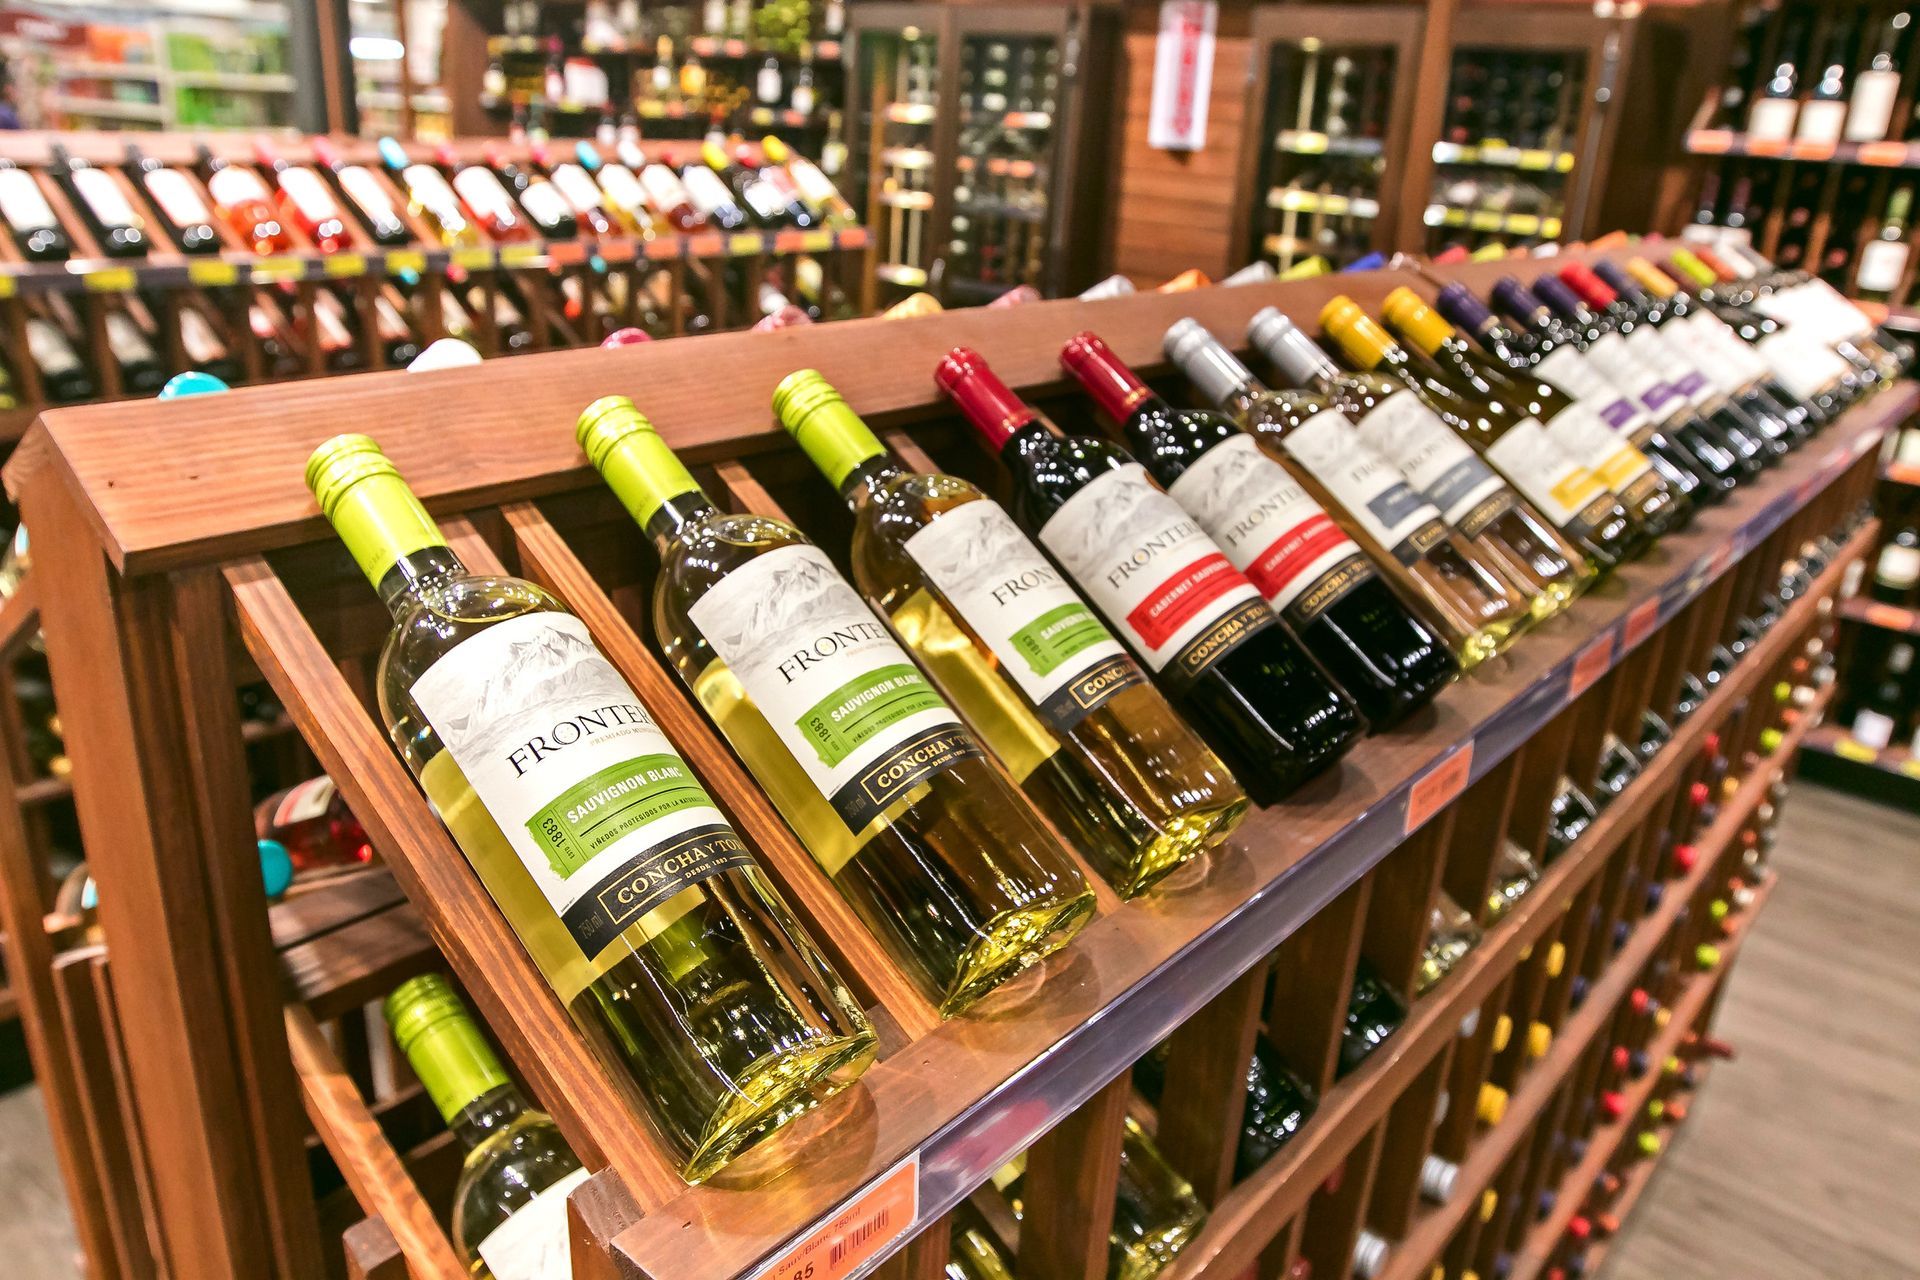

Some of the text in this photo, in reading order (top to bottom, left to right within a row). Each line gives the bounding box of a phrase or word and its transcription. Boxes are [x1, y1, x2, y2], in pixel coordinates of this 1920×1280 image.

[1188, 619, 1244, 666] CONCHA
[830, 679, 896, 722] SAUVIGNON
[810, 717, 832, 742] 1883
[876, 740, 950, 788] CONCHA
[945, 737, 955, 748] Y
[566, 766, 683, 824] SAUVIGNON BLANC
[542, 818, 566, 848] 1883
[589, 828, 619, 850] VIÑEDOS
[619, 806, 659, 833] PROTEGIDOS
[659, 802, 671, 813] POR
[672, 799, 679, 808] LA
[616, 847, 709, 905] CONCHA
[703, 843, 715, 854] Y
[684, 862, 711, 879] DESDE
